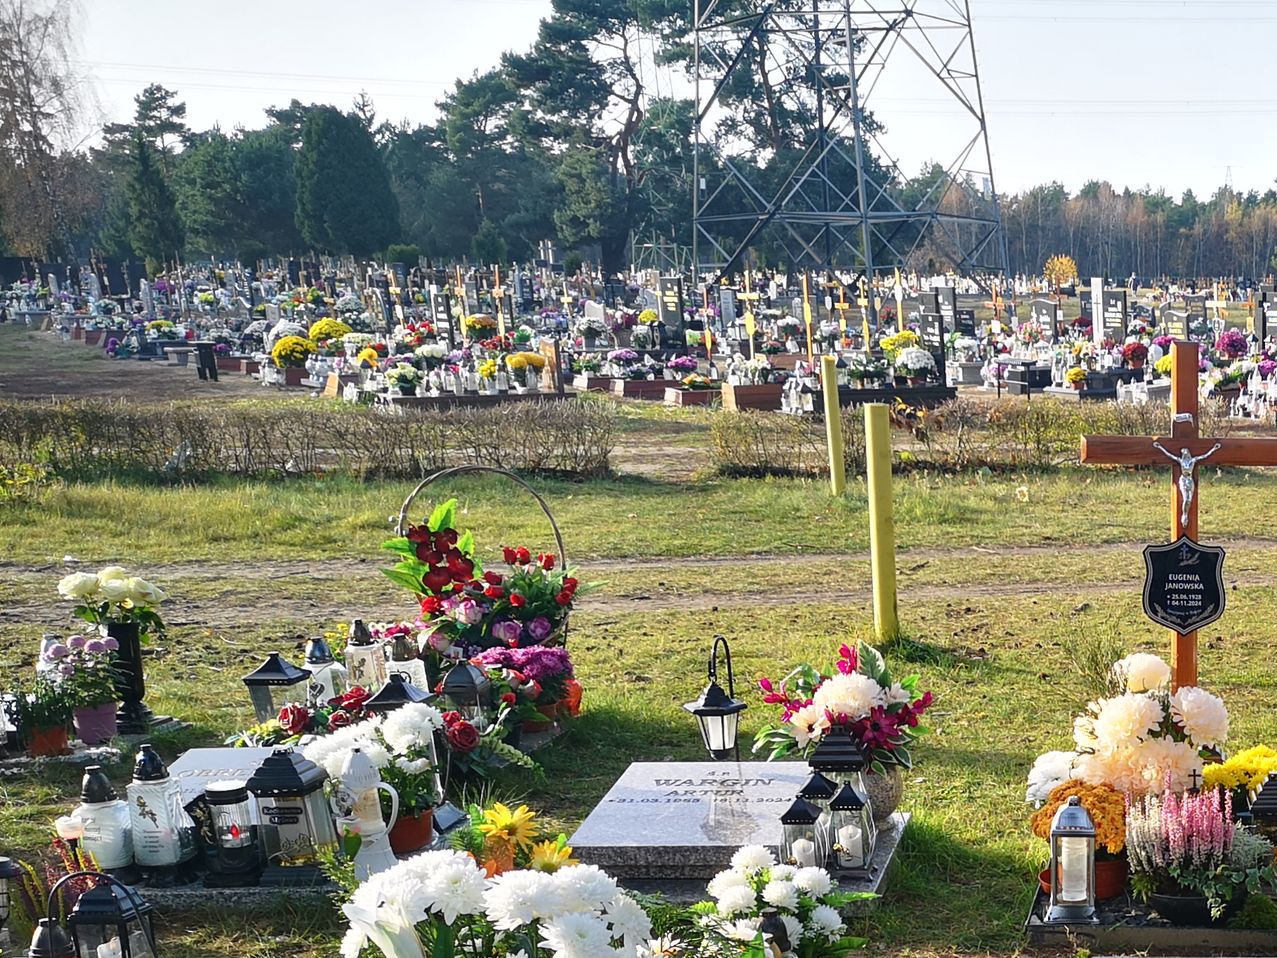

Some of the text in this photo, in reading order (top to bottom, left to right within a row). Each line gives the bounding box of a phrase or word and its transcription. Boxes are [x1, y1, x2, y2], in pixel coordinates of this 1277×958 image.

[1165, 582, 1204, 590] JANOWSKA
[654, 778, 775, 787] WARGIN
[664, 789, 745, 797] ARTUR
